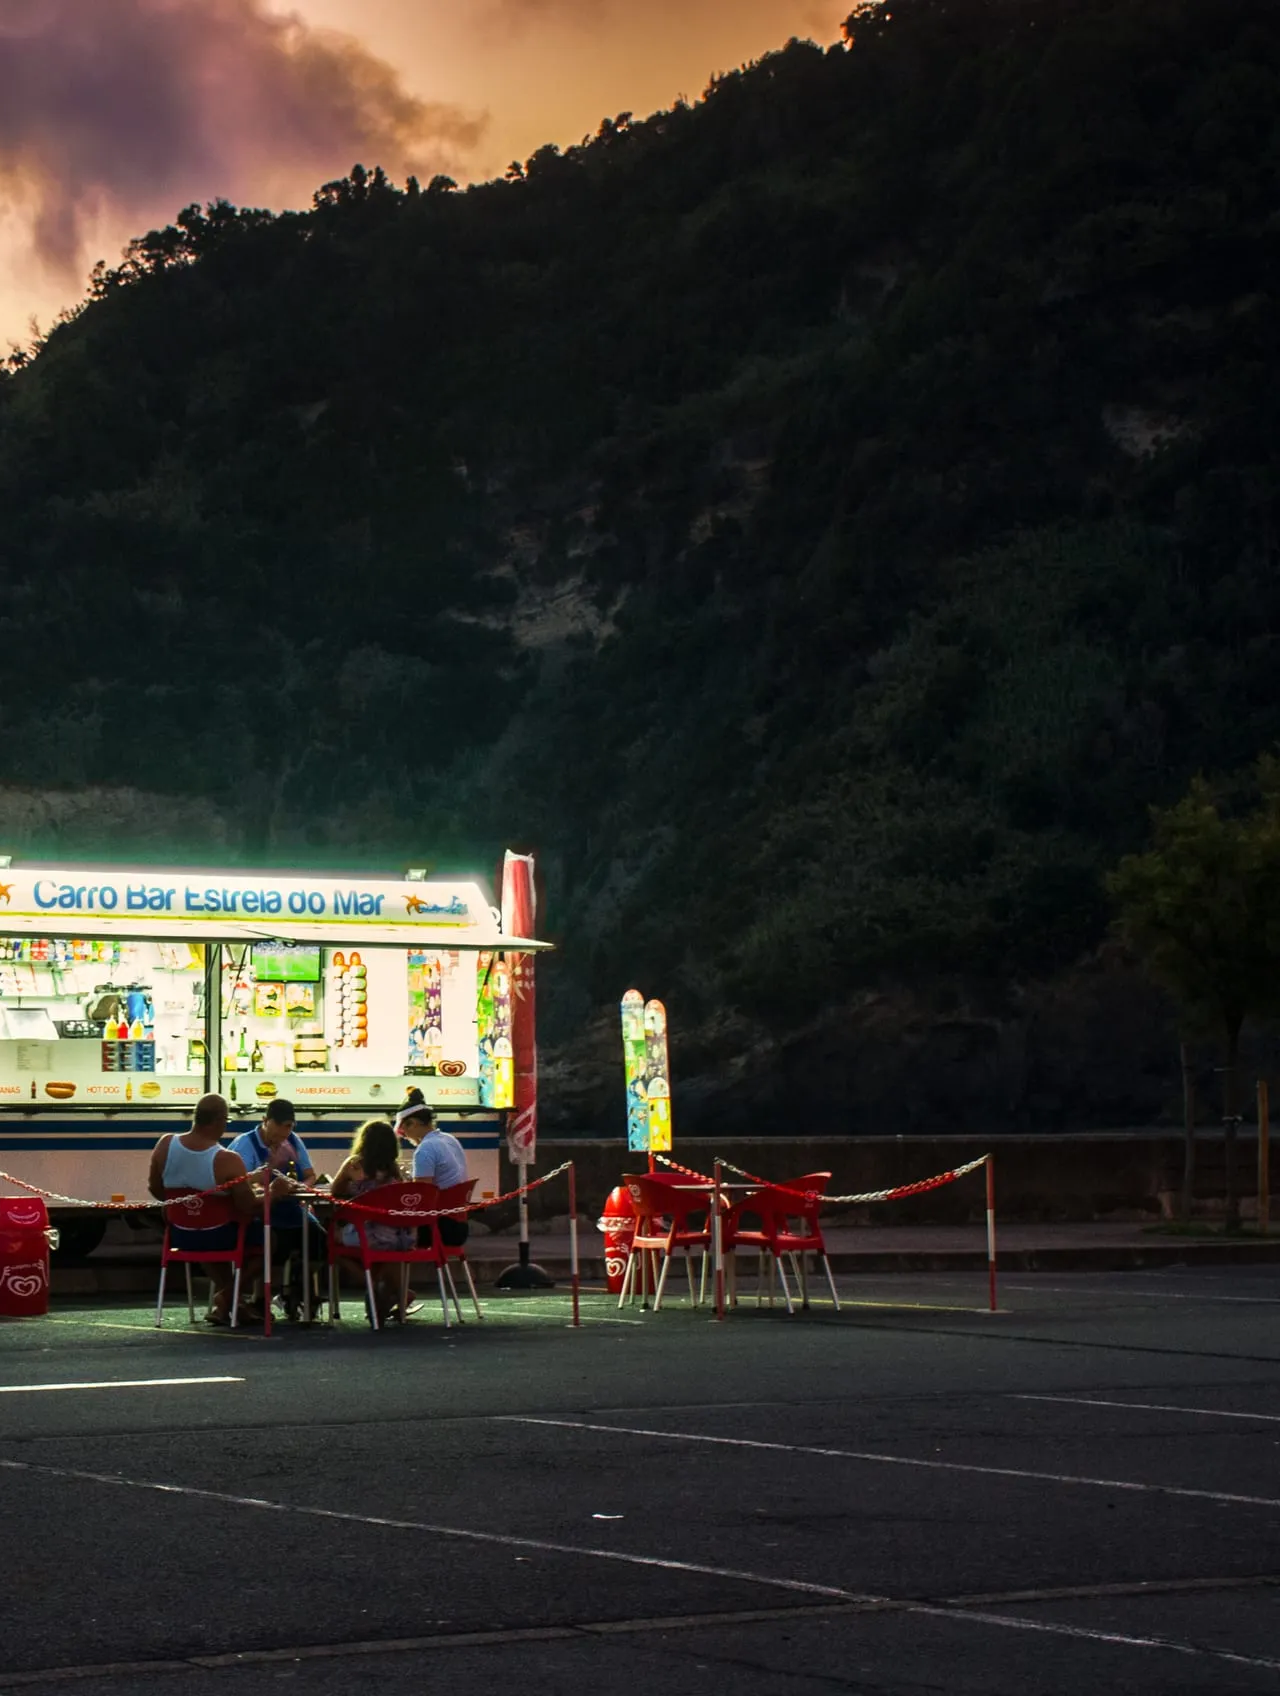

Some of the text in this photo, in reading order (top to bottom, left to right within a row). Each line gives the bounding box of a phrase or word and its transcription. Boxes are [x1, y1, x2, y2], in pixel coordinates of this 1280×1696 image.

[33, 880, 384, 916] Carro Bar Estrela do Mar
[87, 1086, 120, 1094] HOT DOG
